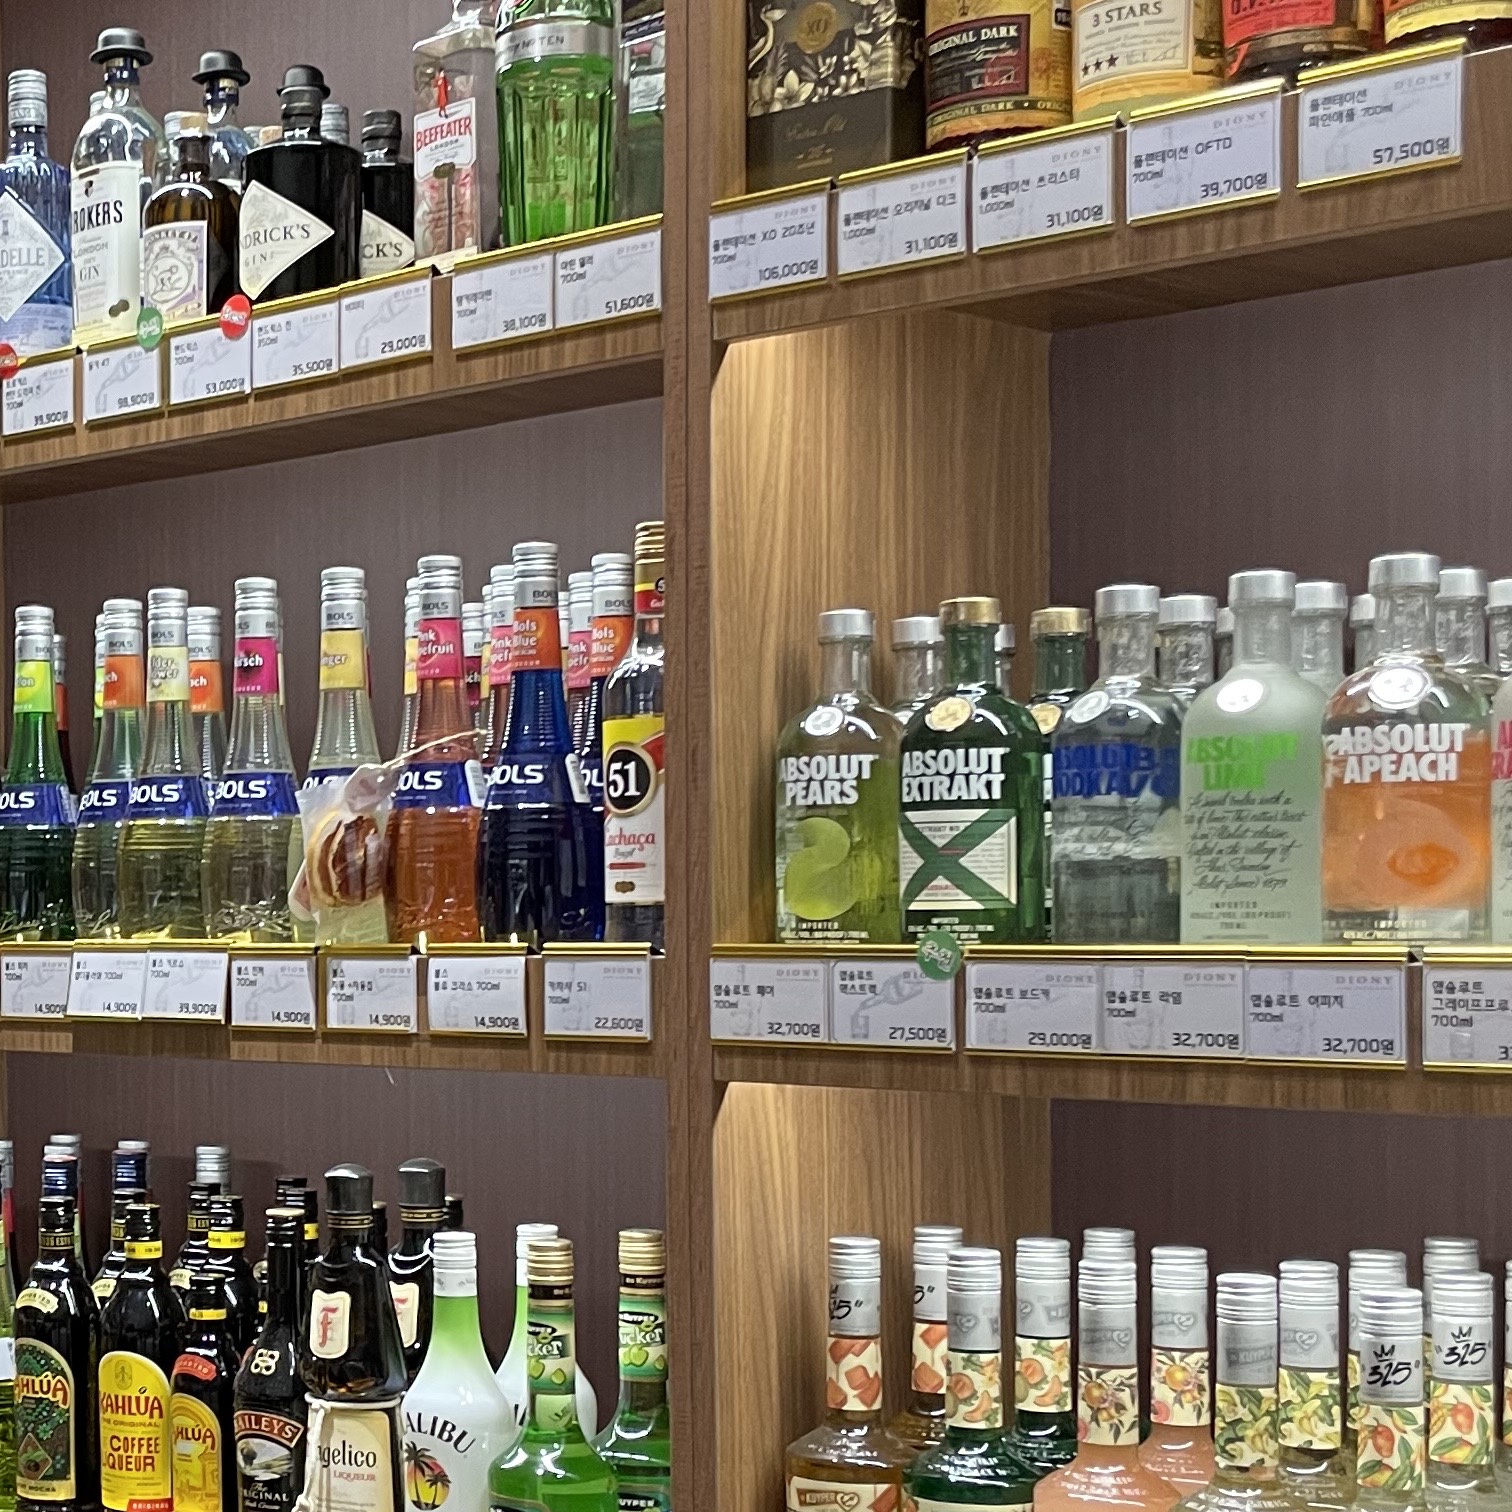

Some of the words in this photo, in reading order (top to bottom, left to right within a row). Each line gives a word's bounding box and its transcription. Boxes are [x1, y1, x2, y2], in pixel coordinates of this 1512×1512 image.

[1091, 13, 1101, 28] 3
[1104, 2, 1163, 23] STARS
[981, 25, 1019, 41] DARK
[984, 100, 1015, 111] DARK
[415, 116, 473, 152] BEEFEATER
[1194, 136, 1233, 155] OFTD
[1372, 137, 1451, 166] 57,500원
[1199, 172, 1268, 199] 39,700원
[1045, 204, 1104, 229] 31,100원
[904, 232, 959, 256] 31,100원
[758, 258, 819, 282] 106,000원
[502, 312, 547, 333] 38,100원
[380, 334, 426, 355] 29,000원
[1338, 723, 1470, 756] ABSOLUT
[779, 754, 879, 781] ABSOLUT
[901, 747, 1011, 778] ABSOLUT
[1343, 753, 1460, 785] APEACH
[215, 777, 268, 800] BOLS
[607, 761, 641, 800] 51
[901, 773, 1006, 803] EXTRAKT
[129, 783, 184, 804] BOLS
[785, 780, 860, 806] PEARS
[1431, 980, 1485, 996] 앱솔루트
[368, 1012, 411, 1028] 14,900원
[473, 1015, 520, 1031] 14,900원
[766, 1021, 821, 1038] 32,700원
[1431, 1014, 1474, 1028] 700ml
[888, 1026, 947, 1042] 27,500원
[1028, 1031, 1092, 1049] 29,000원
[1171, 1032, 1240, 1050] 32,700원
[1322, 1037, 1394, 1055] 32,700원
[109, 1434, 161, 1455] COFFEE
